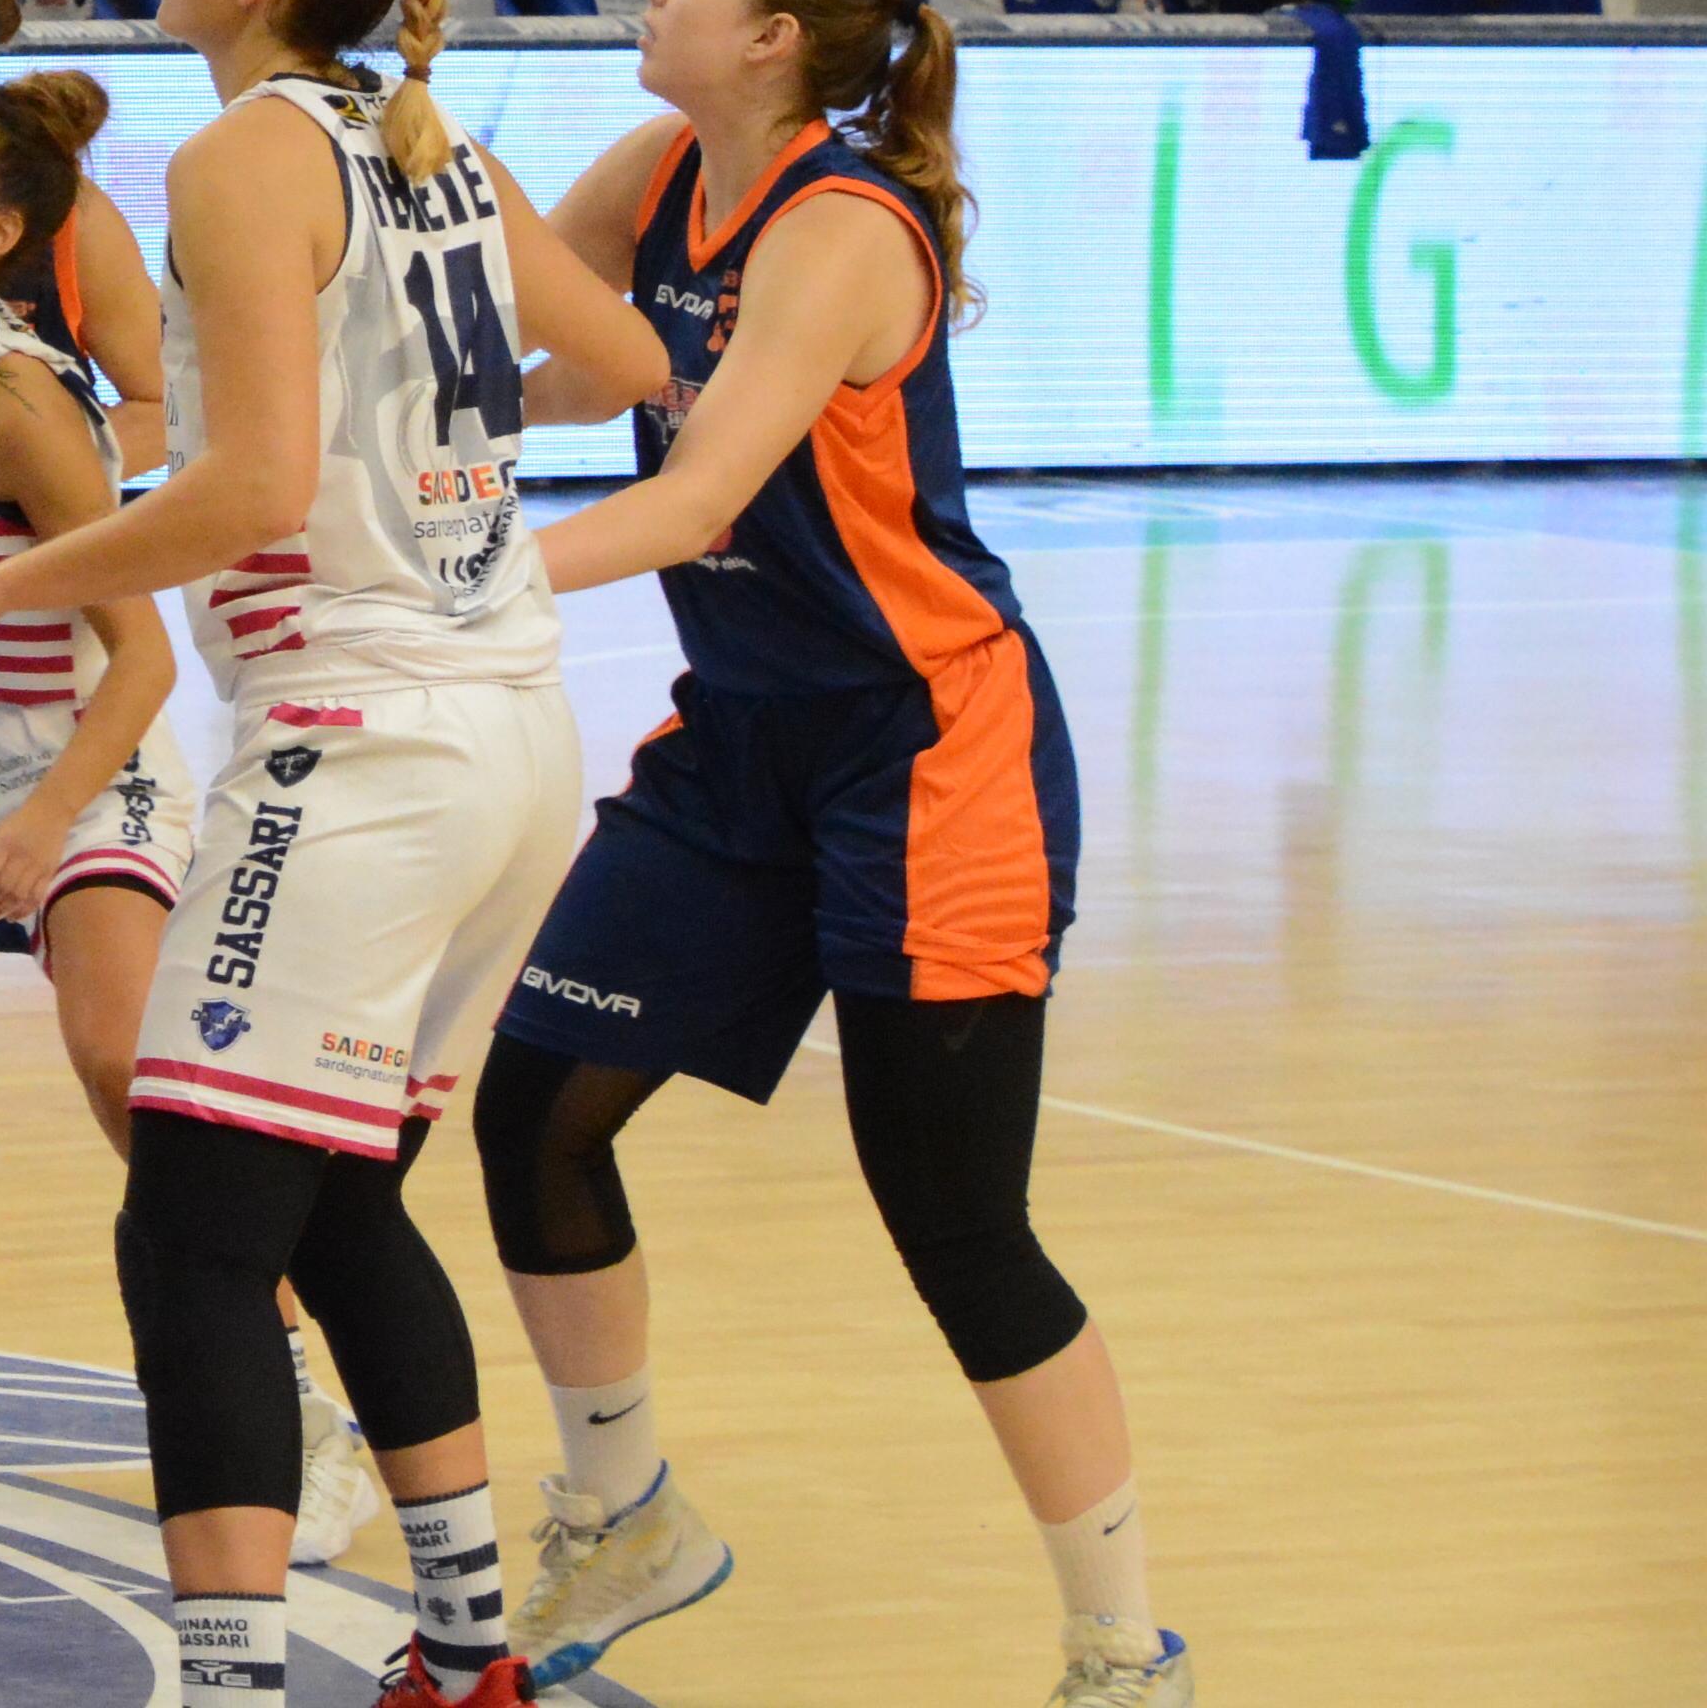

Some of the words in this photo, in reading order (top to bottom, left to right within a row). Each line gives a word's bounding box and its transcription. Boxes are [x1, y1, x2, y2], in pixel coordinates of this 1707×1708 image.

[403, 241, 524, 446] 14
[206, 800, 304, 990] SASSARI
[522, 965, 642, 1020] GIVOVA
[321, 1031, 407, 1069] SARDEG
[177, 1618, 249, 1633] DINAMO
[178, 1633, 250, 1649] SASSARI
